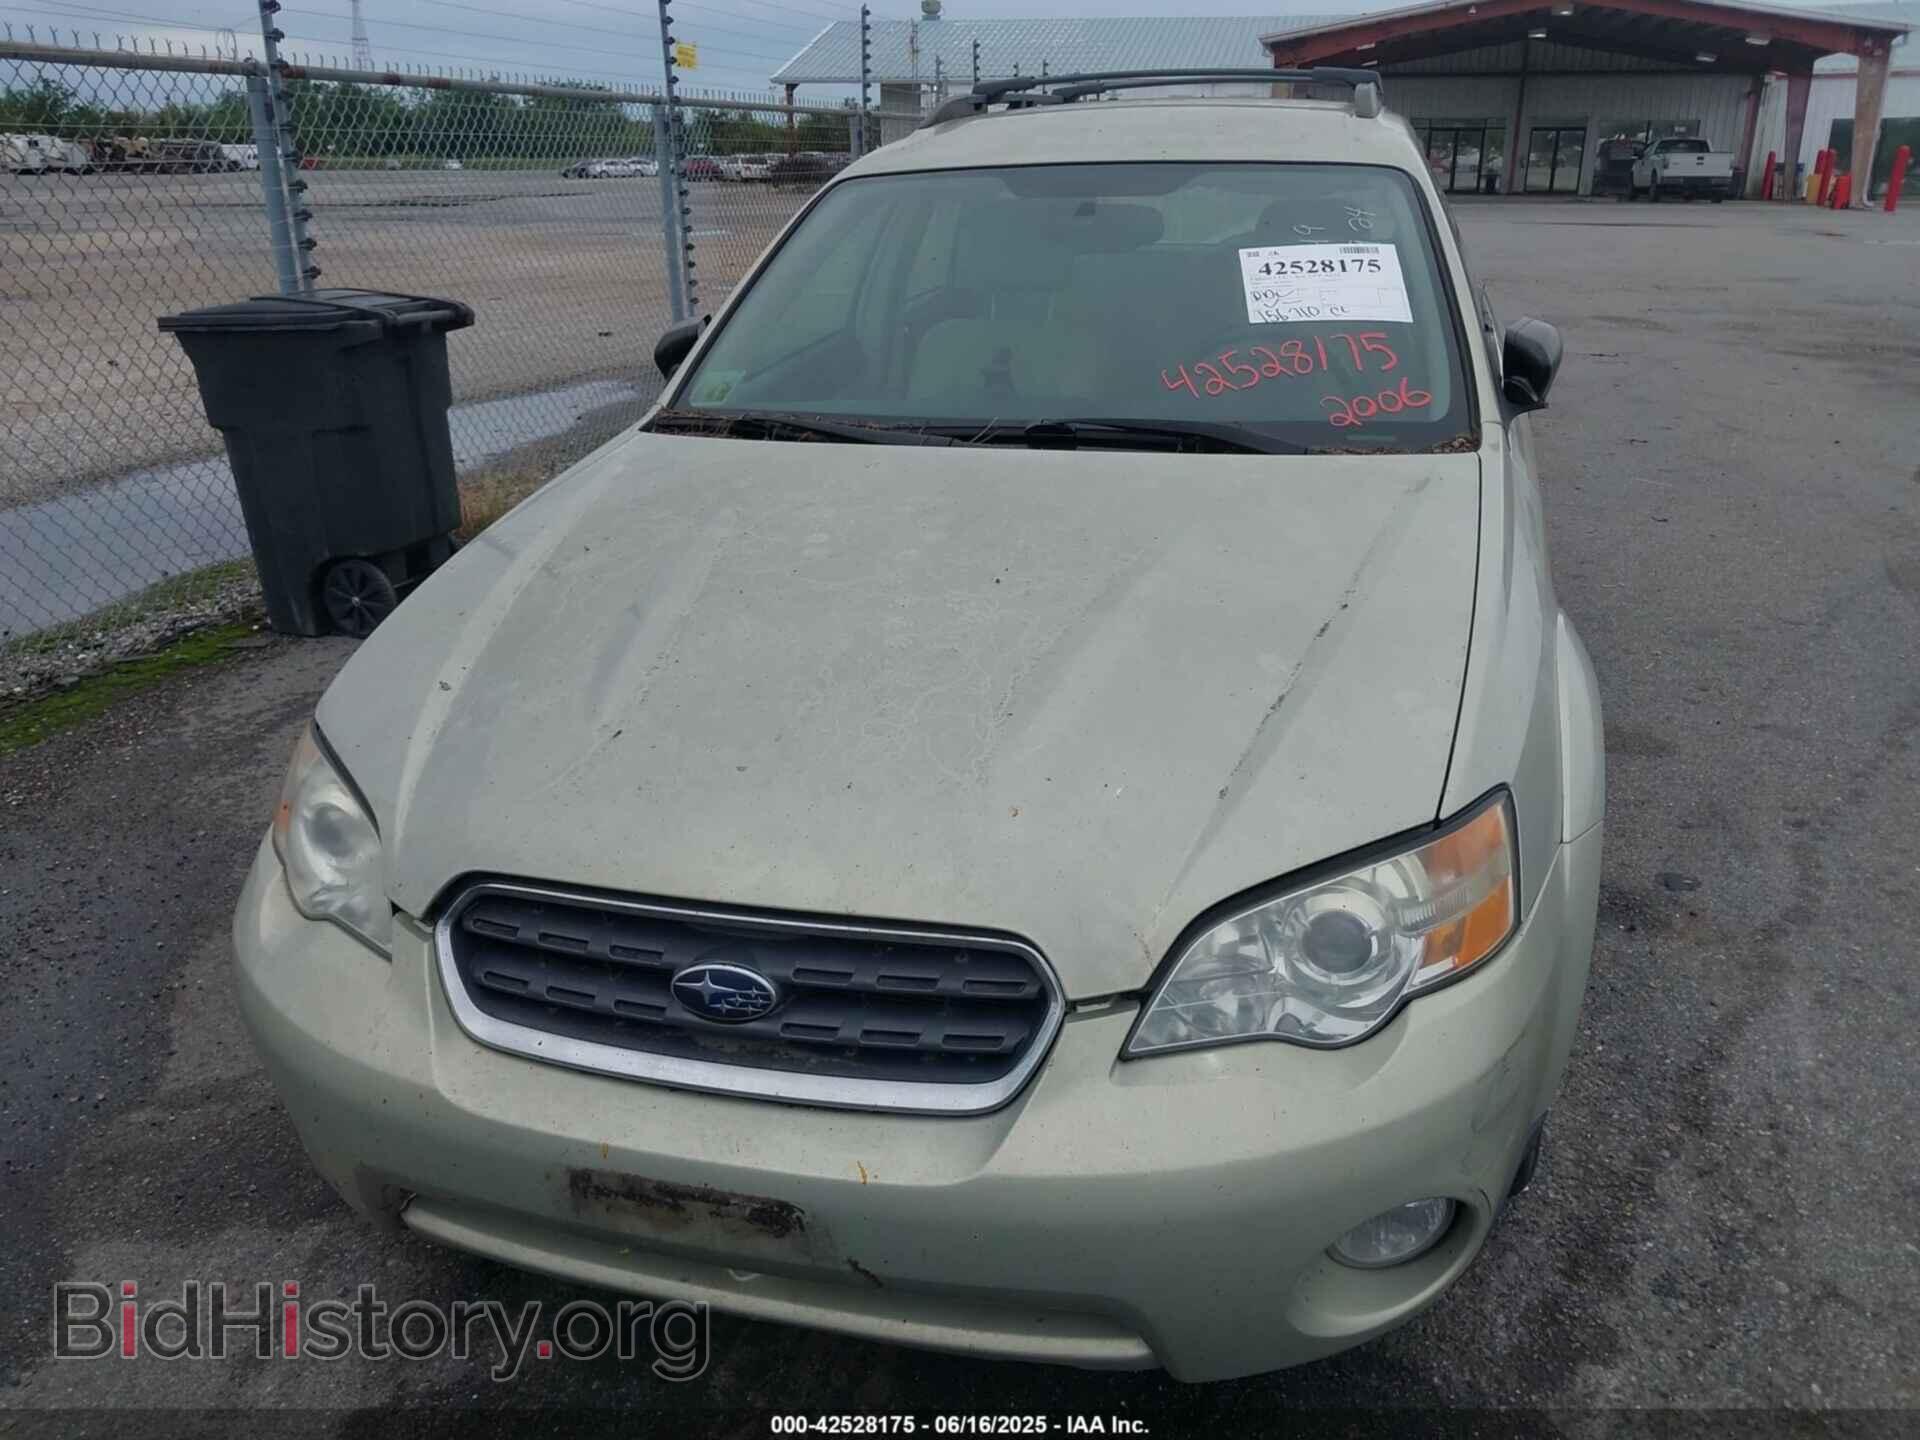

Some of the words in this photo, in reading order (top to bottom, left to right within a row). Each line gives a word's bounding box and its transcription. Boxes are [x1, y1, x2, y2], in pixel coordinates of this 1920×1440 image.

[1258, 258, 1381, 276] 42528175
[1161, 332, 1399, 399] 42528175
[1320, 377, 1433, 426] 2006
